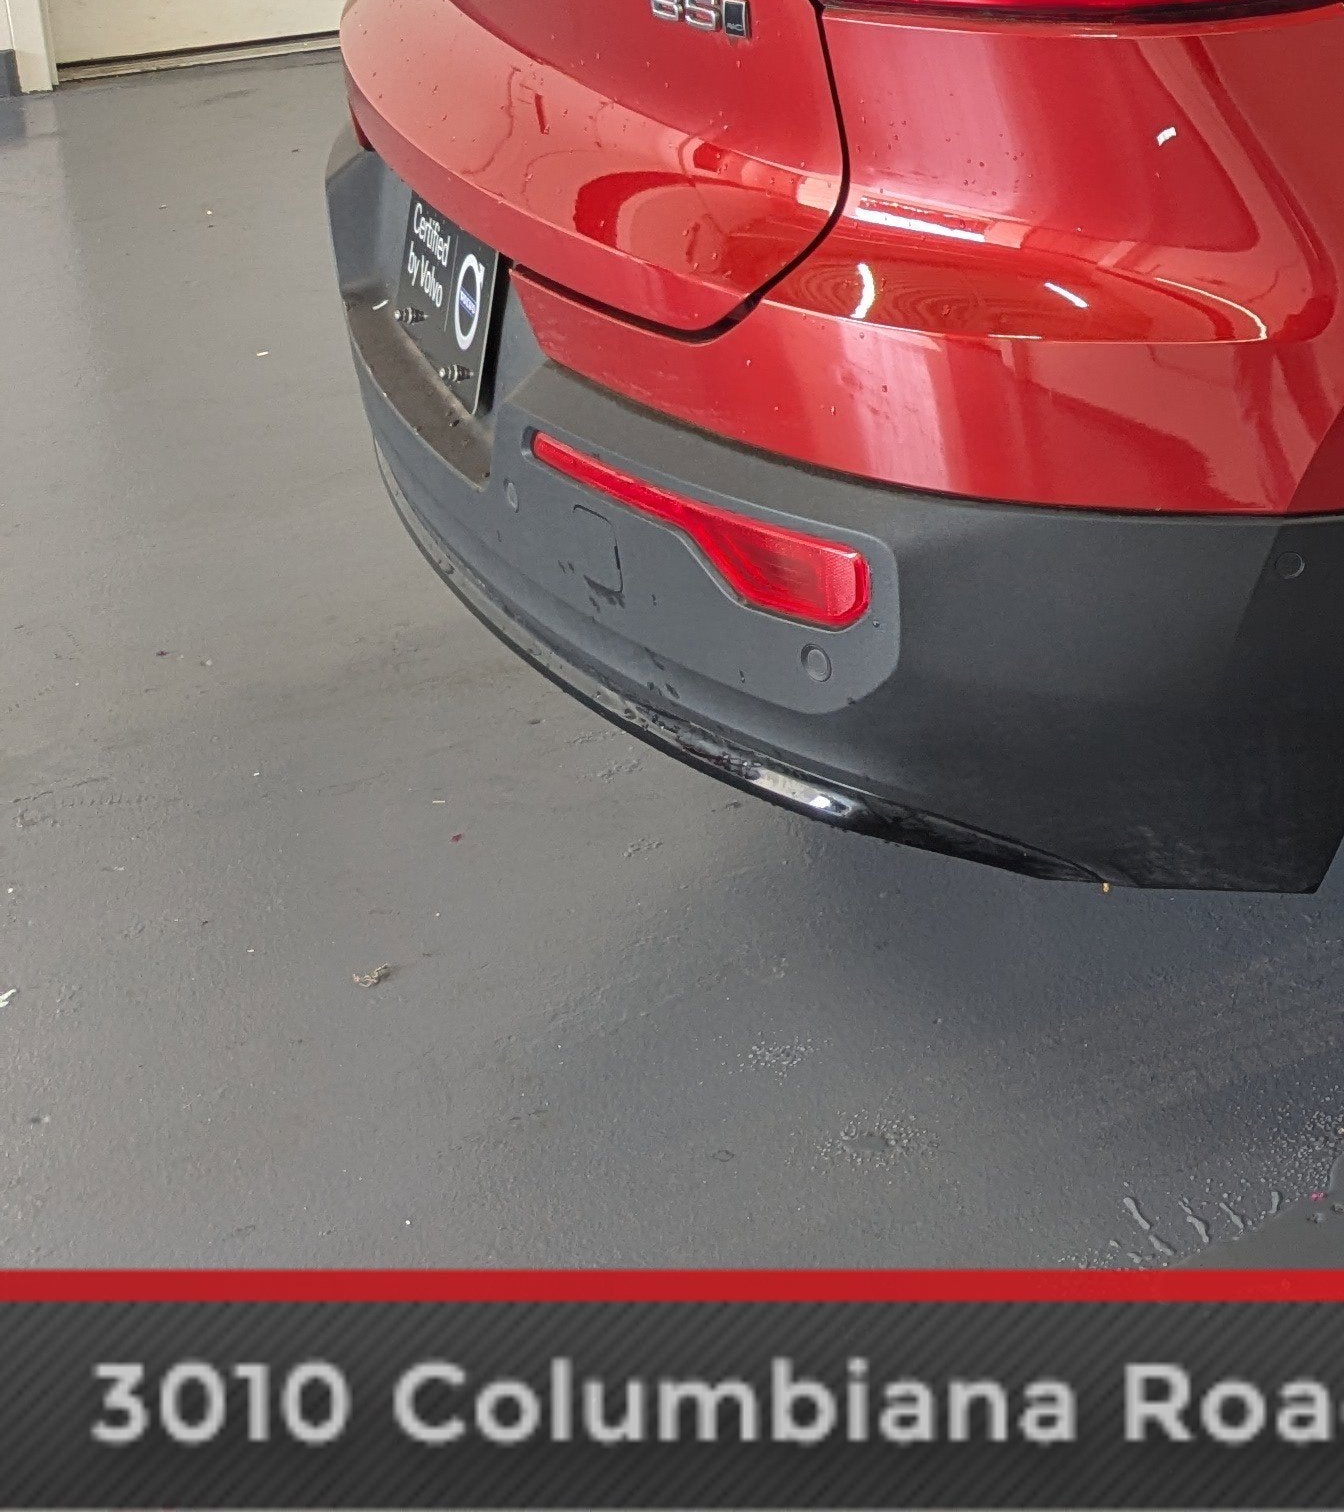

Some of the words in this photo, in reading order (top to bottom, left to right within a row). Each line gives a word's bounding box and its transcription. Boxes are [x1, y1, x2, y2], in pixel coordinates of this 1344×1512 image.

[413, 201, 451, 268] Certified
[407, 240, 420, 287] by
[420, 254, 443, 308] Volvo
